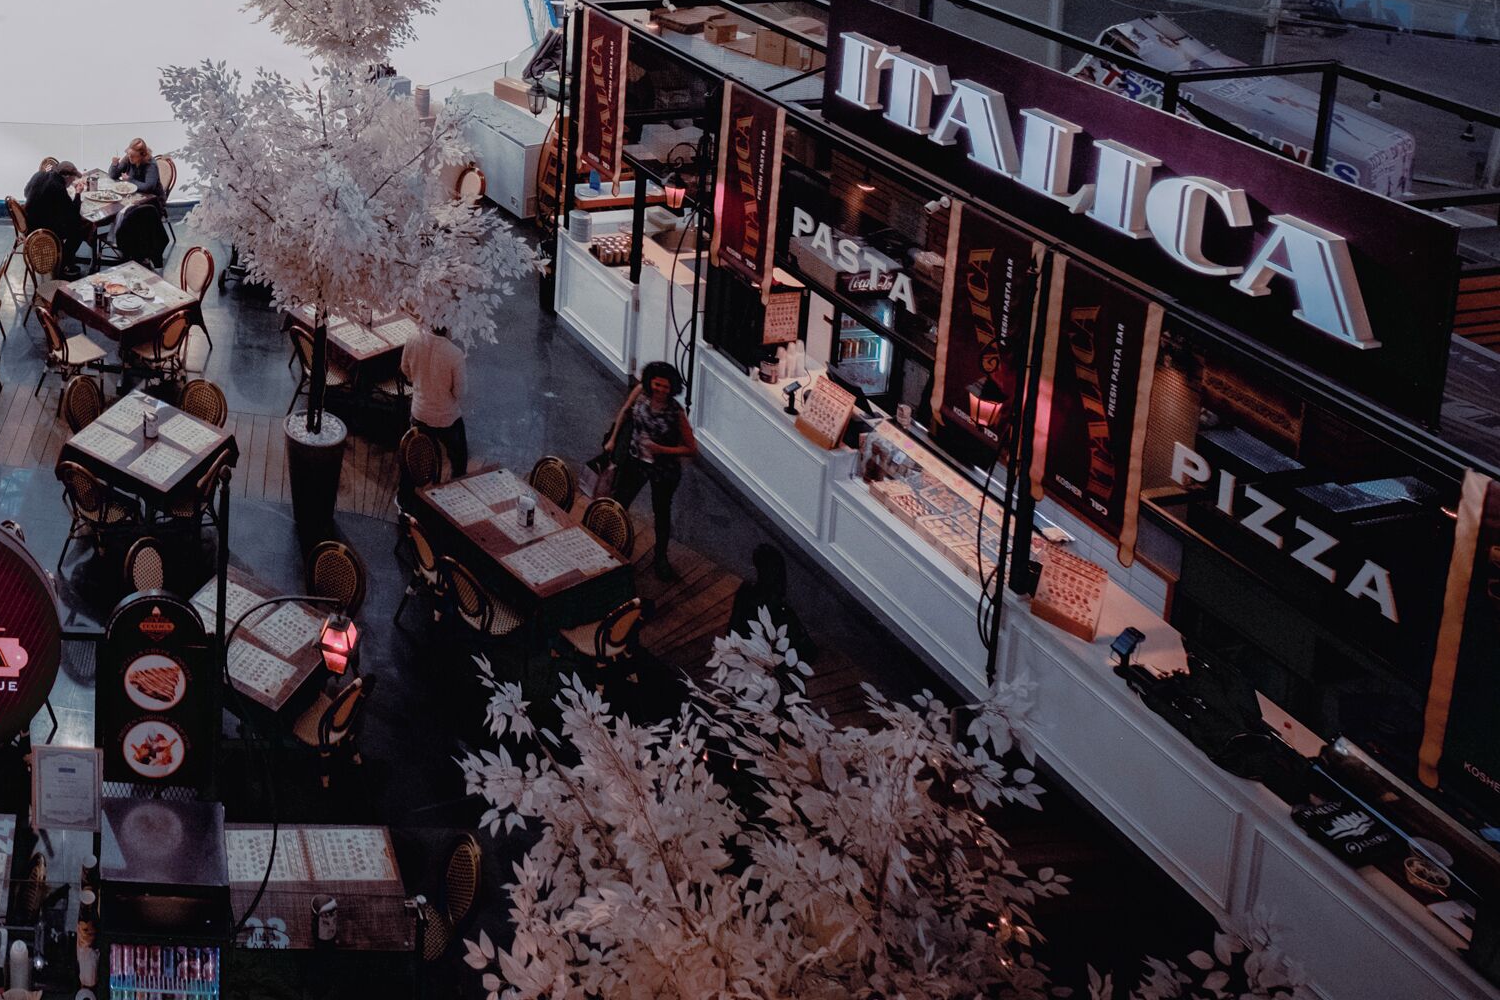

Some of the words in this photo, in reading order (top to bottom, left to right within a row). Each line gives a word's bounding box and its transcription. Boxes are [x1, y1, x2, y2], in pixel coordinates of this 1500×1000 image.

[835, 31, 1384, 350] ITALICA
[792, 206, 917, 315] PASTA
[1110, 348, 1123, 382] PASTA
[1115, 322, 1125, 346] BAR
[1107, 383, 1119, 418] FRESH
[1170, 439, 1400, 624] PIZZA
